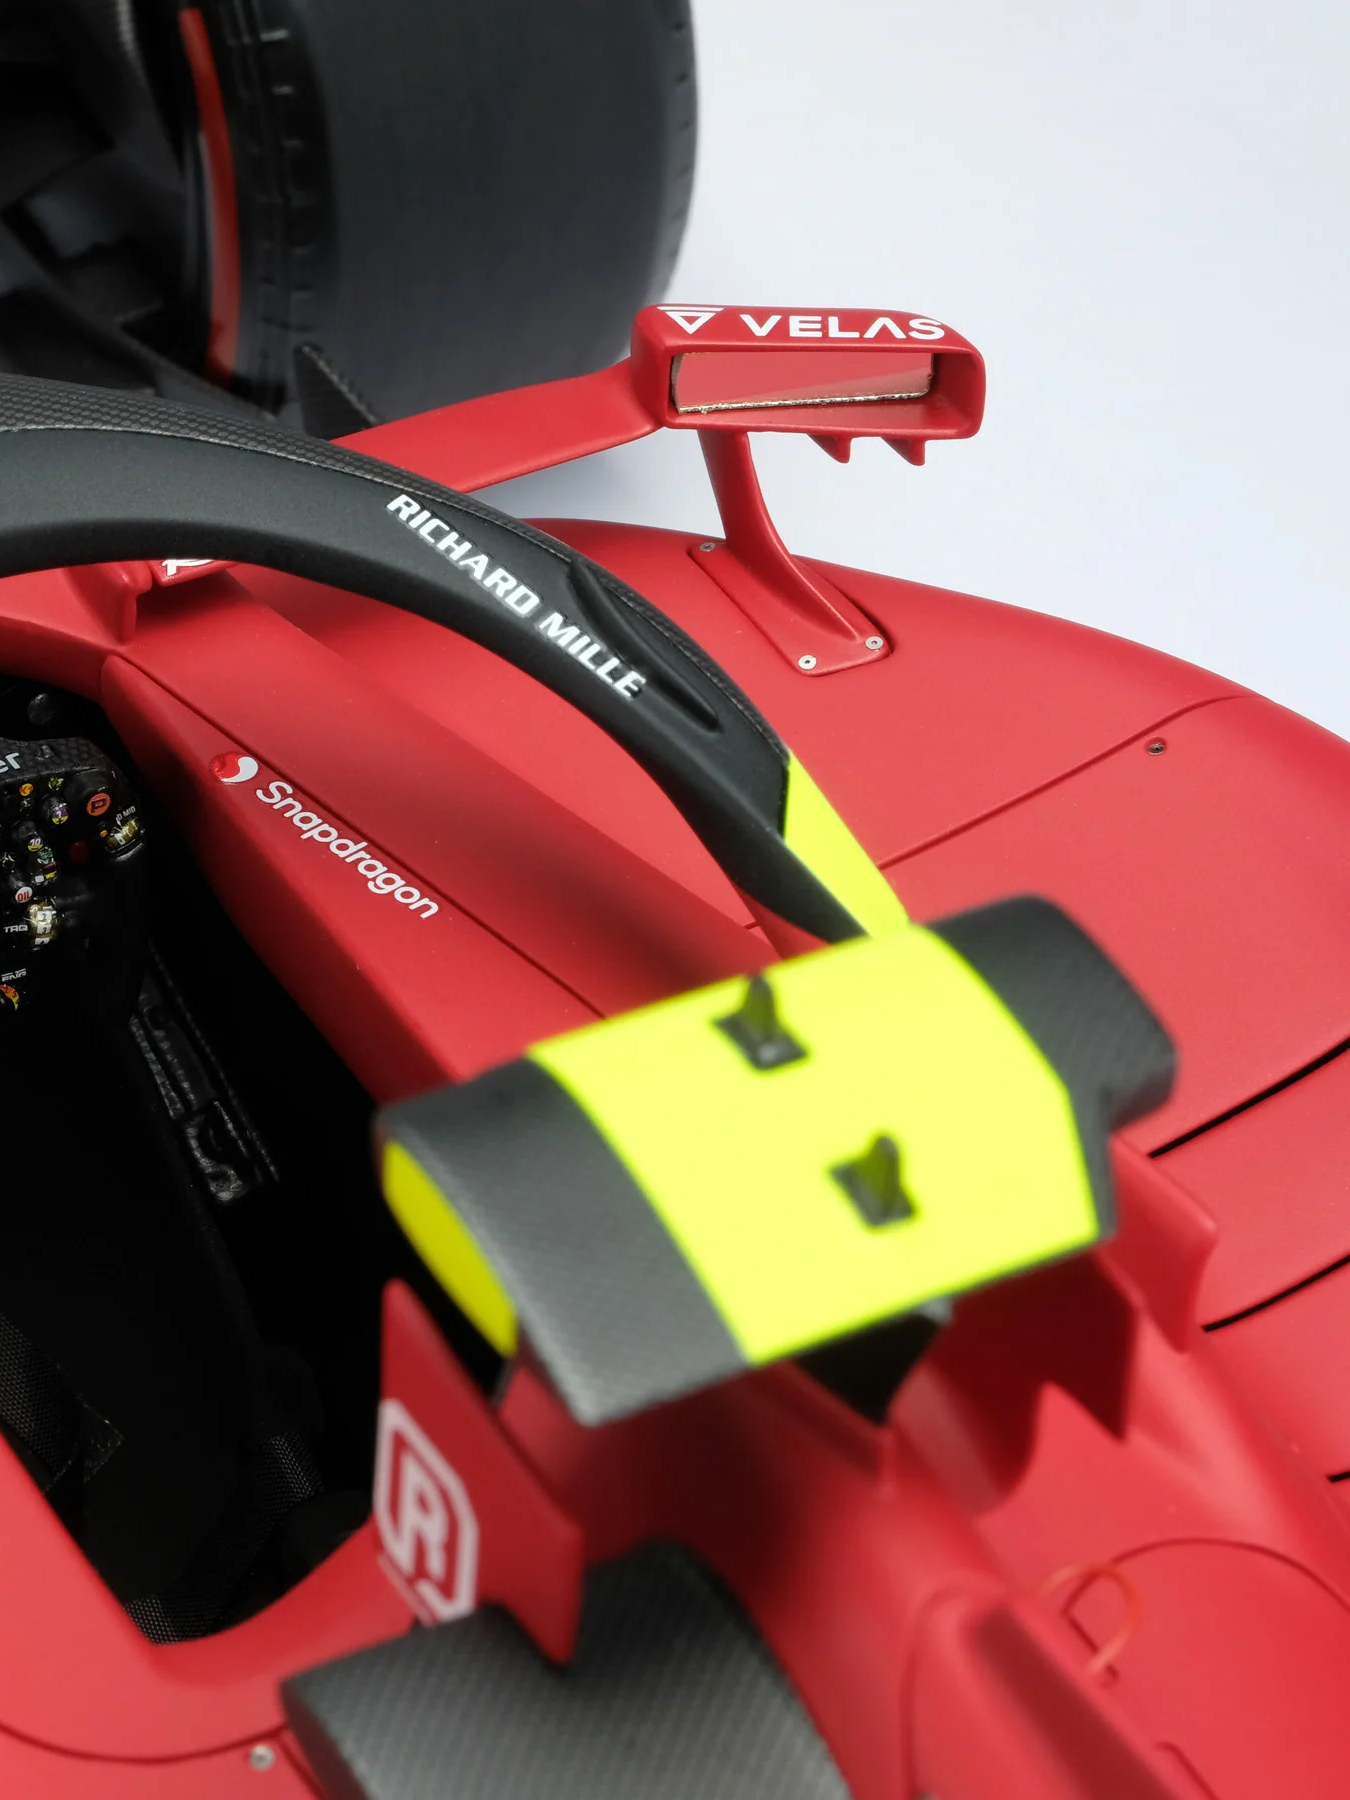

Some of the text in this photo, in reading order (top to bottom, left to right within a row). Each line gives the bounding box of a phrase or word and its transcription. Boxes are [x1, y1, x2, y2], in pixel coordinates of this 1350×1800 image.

[386, 493, 646, 698] RICHARD MILLE
[256, 781, 439, 919] Snapdragon
[3, 924, 29, 933] TRQ
[17, 890, 31, 902] OIL
